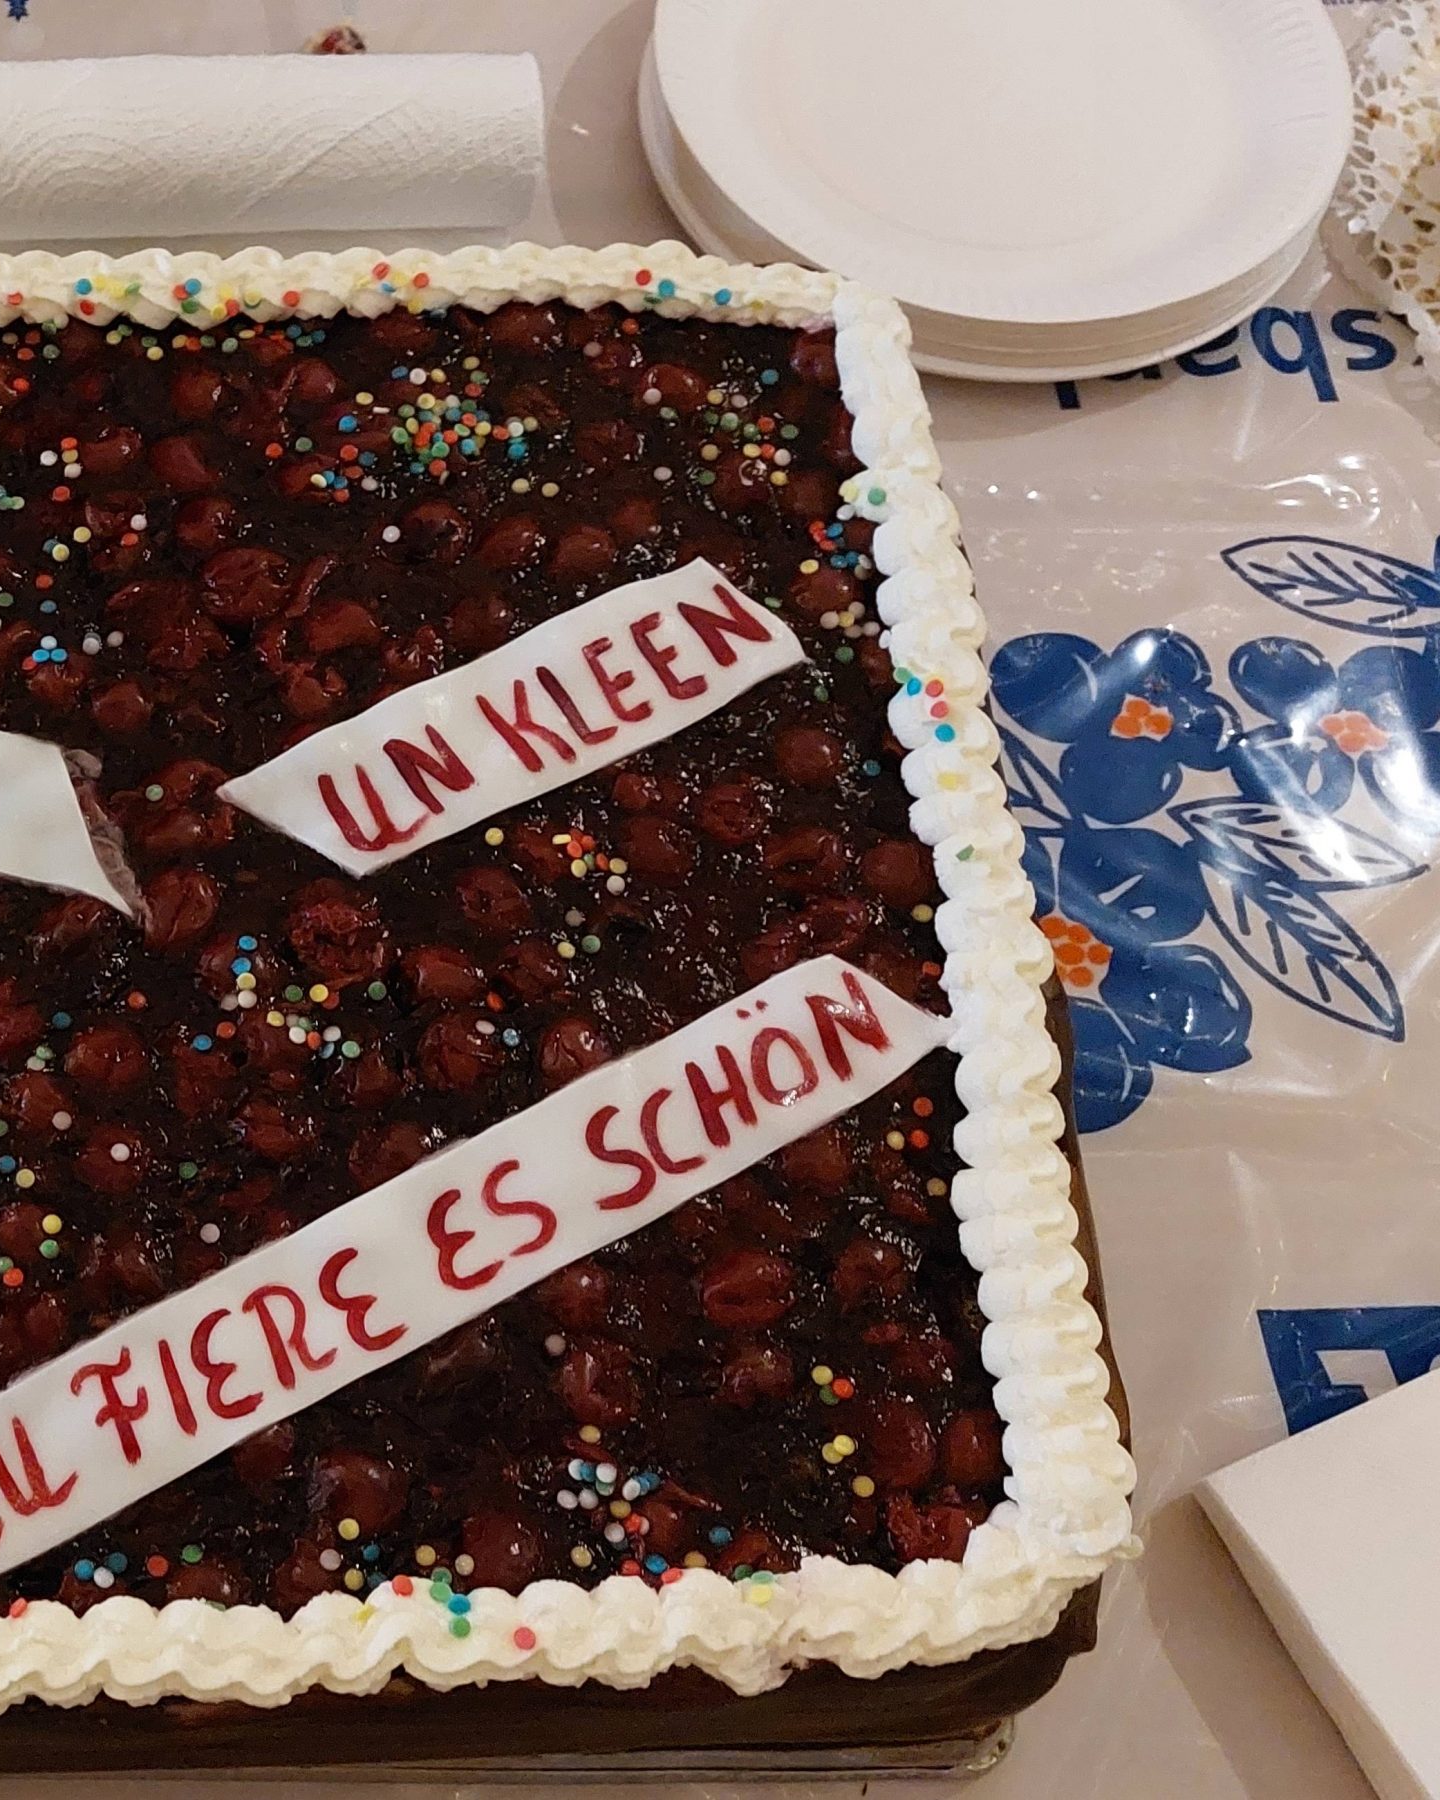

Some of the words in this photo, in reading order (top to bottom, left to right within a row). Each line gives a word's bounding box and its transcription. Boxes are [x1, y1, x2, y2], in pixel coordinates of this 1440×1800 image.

[317, 723, 475, 852] UN
[476, 583, 773, 773] KLEEN
[70, 1247, 409, 1466] FIERE
[426, 1159, 557, 1291] ES
[584, 970, 892, 1211] SCHÖN
